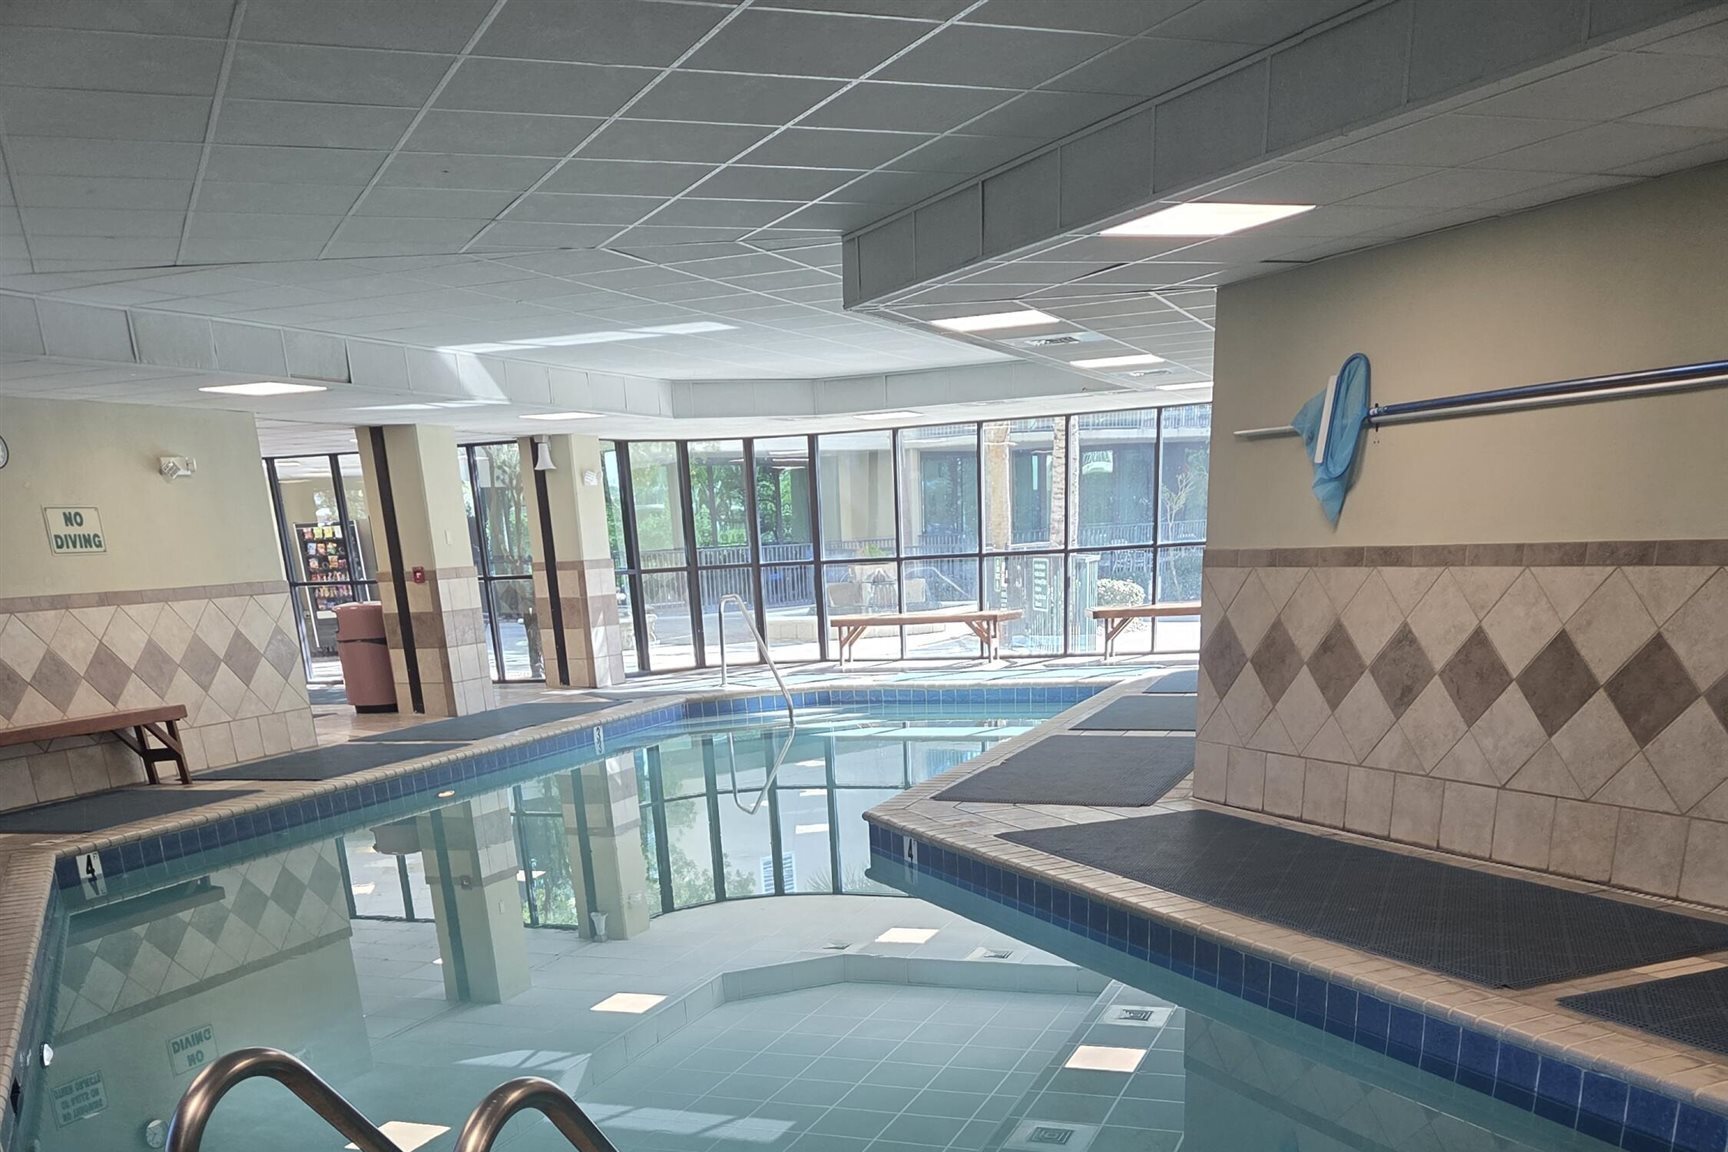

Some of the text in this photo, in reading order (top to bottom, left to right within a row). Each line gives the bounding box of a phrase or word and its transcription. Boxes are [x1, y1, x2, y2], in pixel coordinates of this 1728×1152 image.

[62, 511, 84, 527] NO
[53, 533, 103, 549] DIVING
[907, 838, 914, 862] 4
[85, 854, 96, 878] 4
